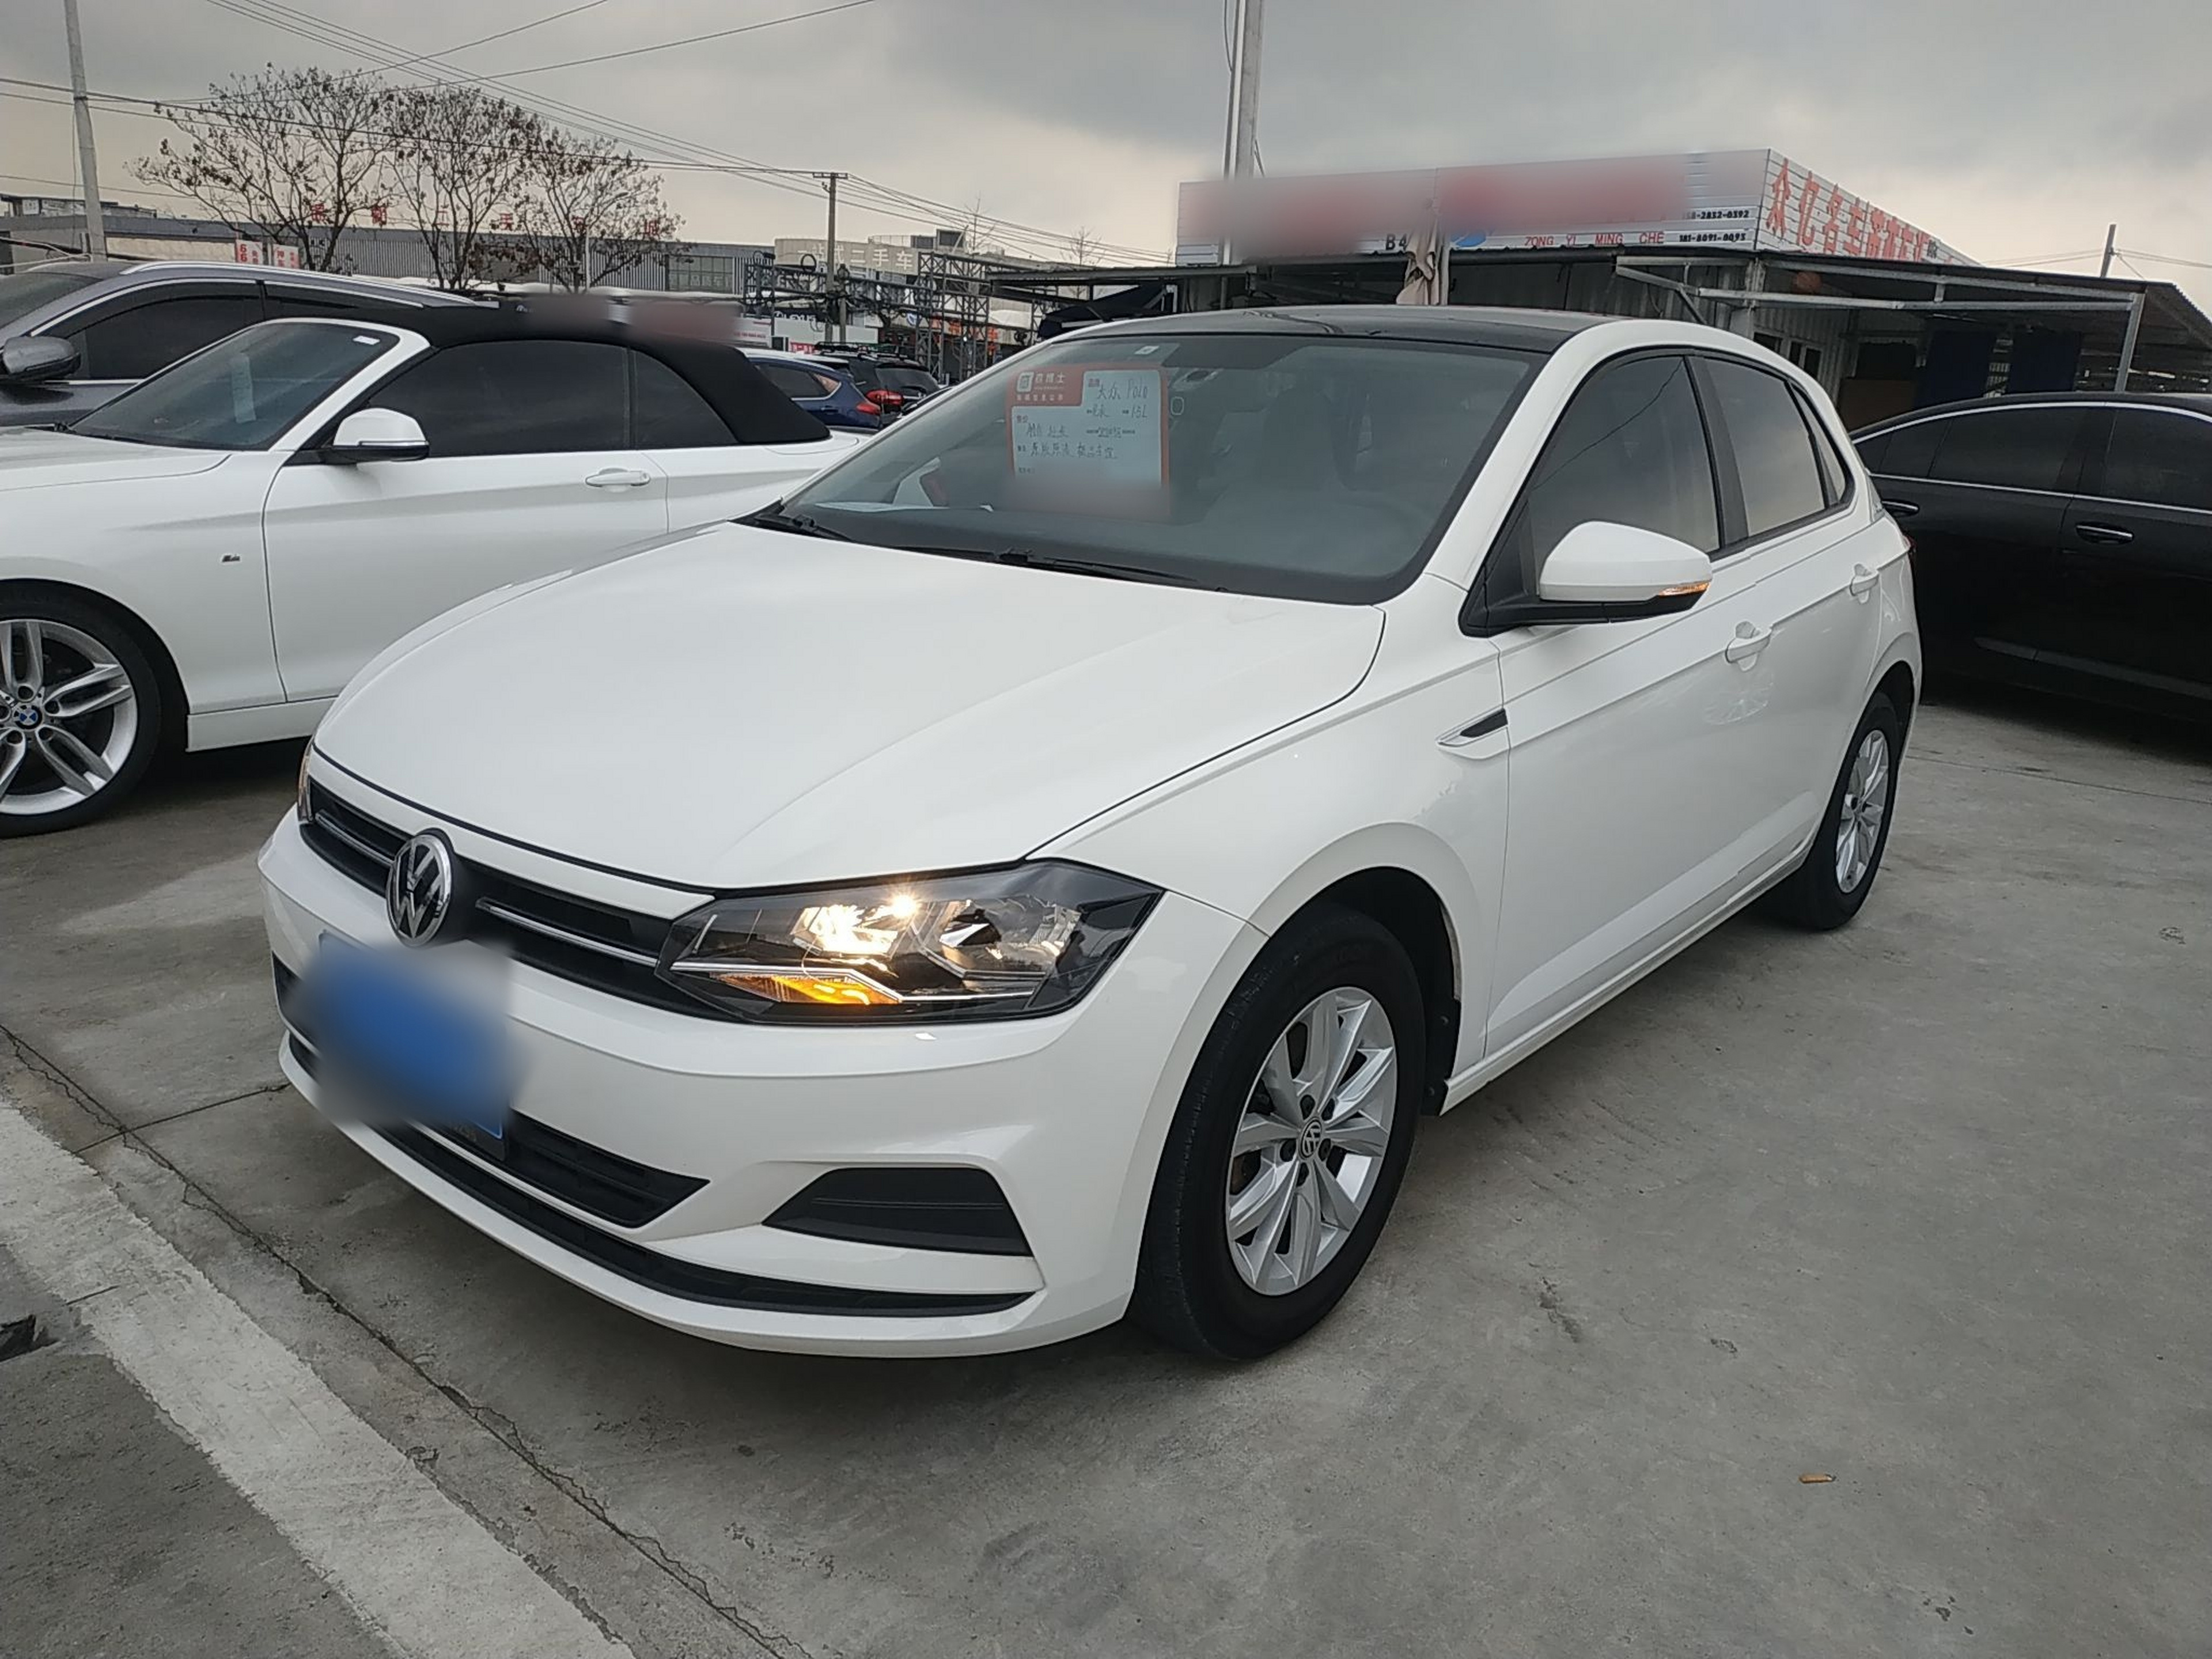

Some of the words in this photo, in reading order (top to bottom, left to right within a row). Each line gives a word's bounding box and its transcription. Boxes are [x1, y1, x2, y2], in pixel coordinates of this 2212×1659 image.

[1525, 236, 1554, 247] ZONG
[1566, 235, 1577, 246] YI
[1594, 233, 1624, 245] MING
[1639, 231, 1665, 244] CHE
